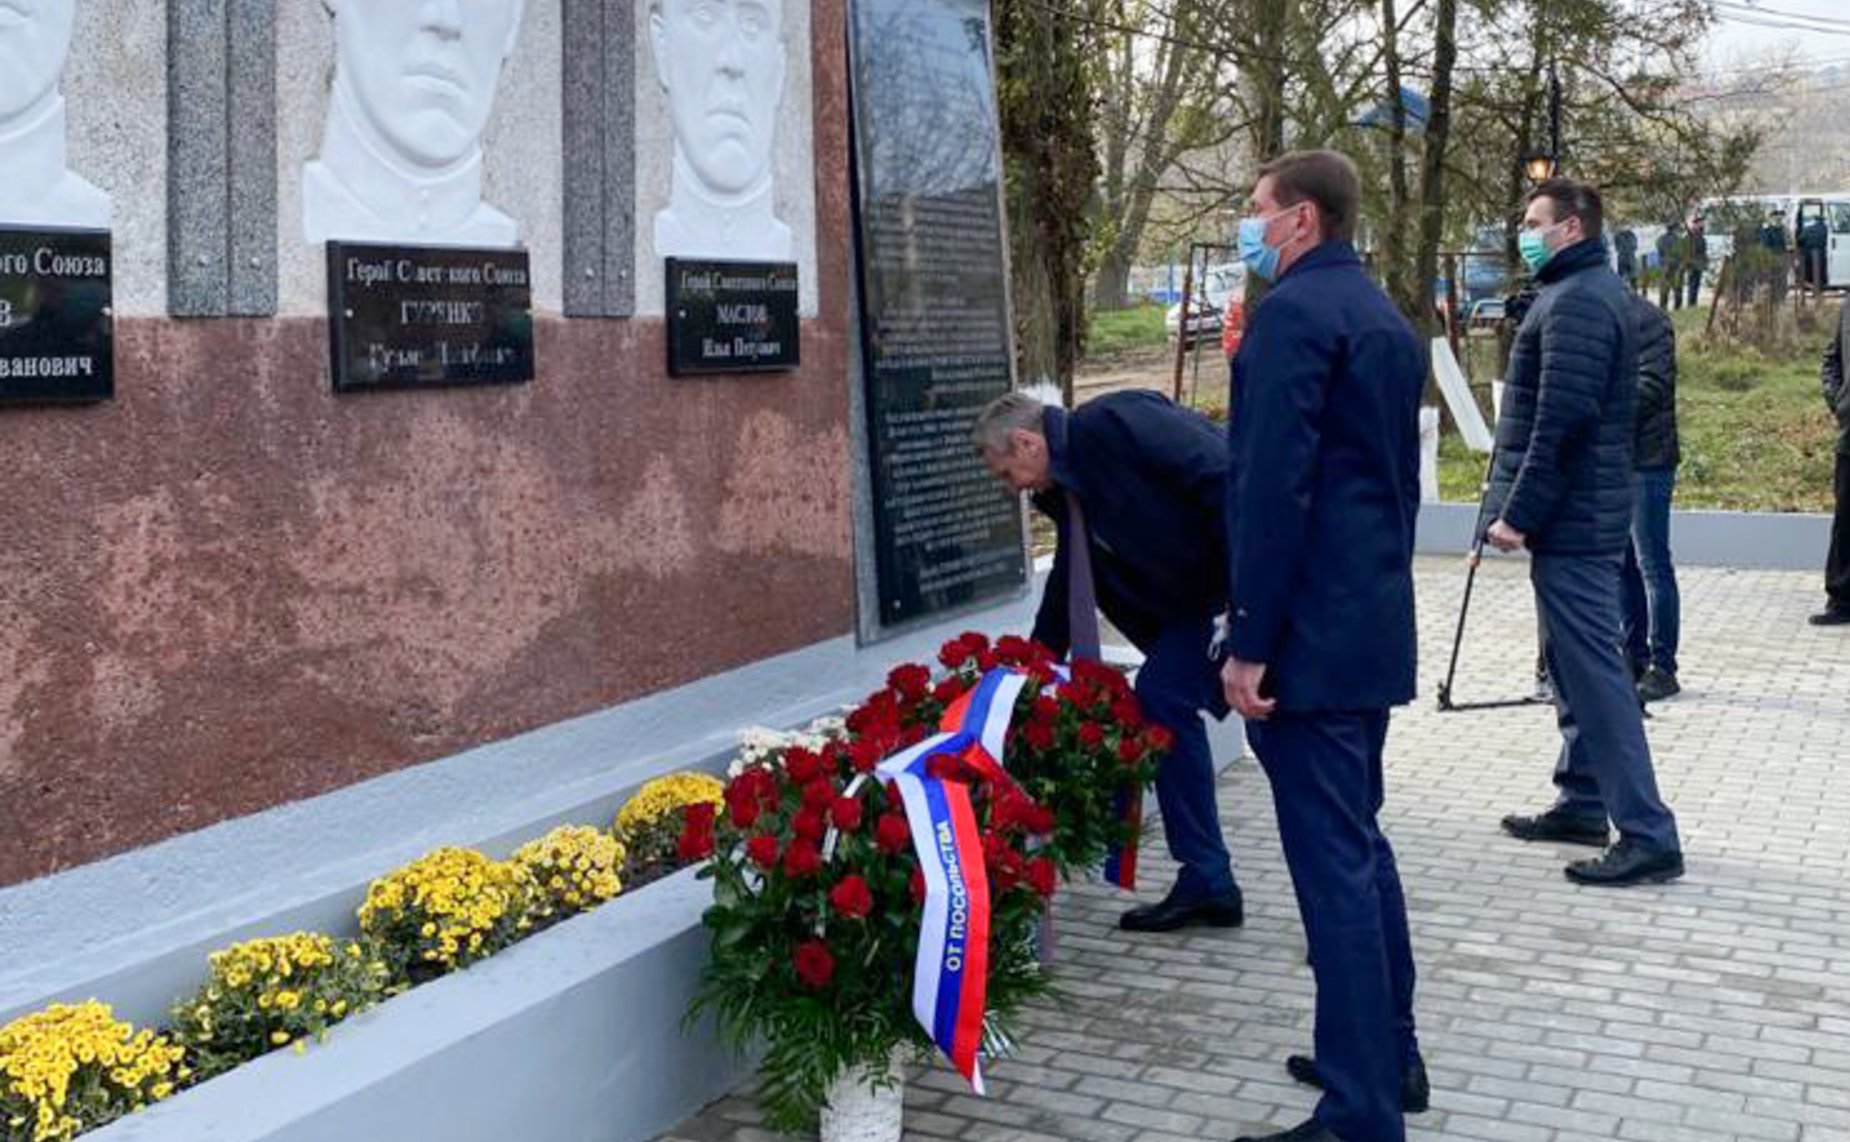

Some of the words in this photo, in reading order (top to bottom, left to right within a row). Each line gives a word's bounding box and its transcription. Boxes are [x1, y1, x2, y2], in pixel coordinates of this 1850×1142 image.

[34, 248, 105, 275] Союза
[937, 819, 966, 939] ПОСОЛЬСТВА
[946, 942, 963, 971] ОТ
